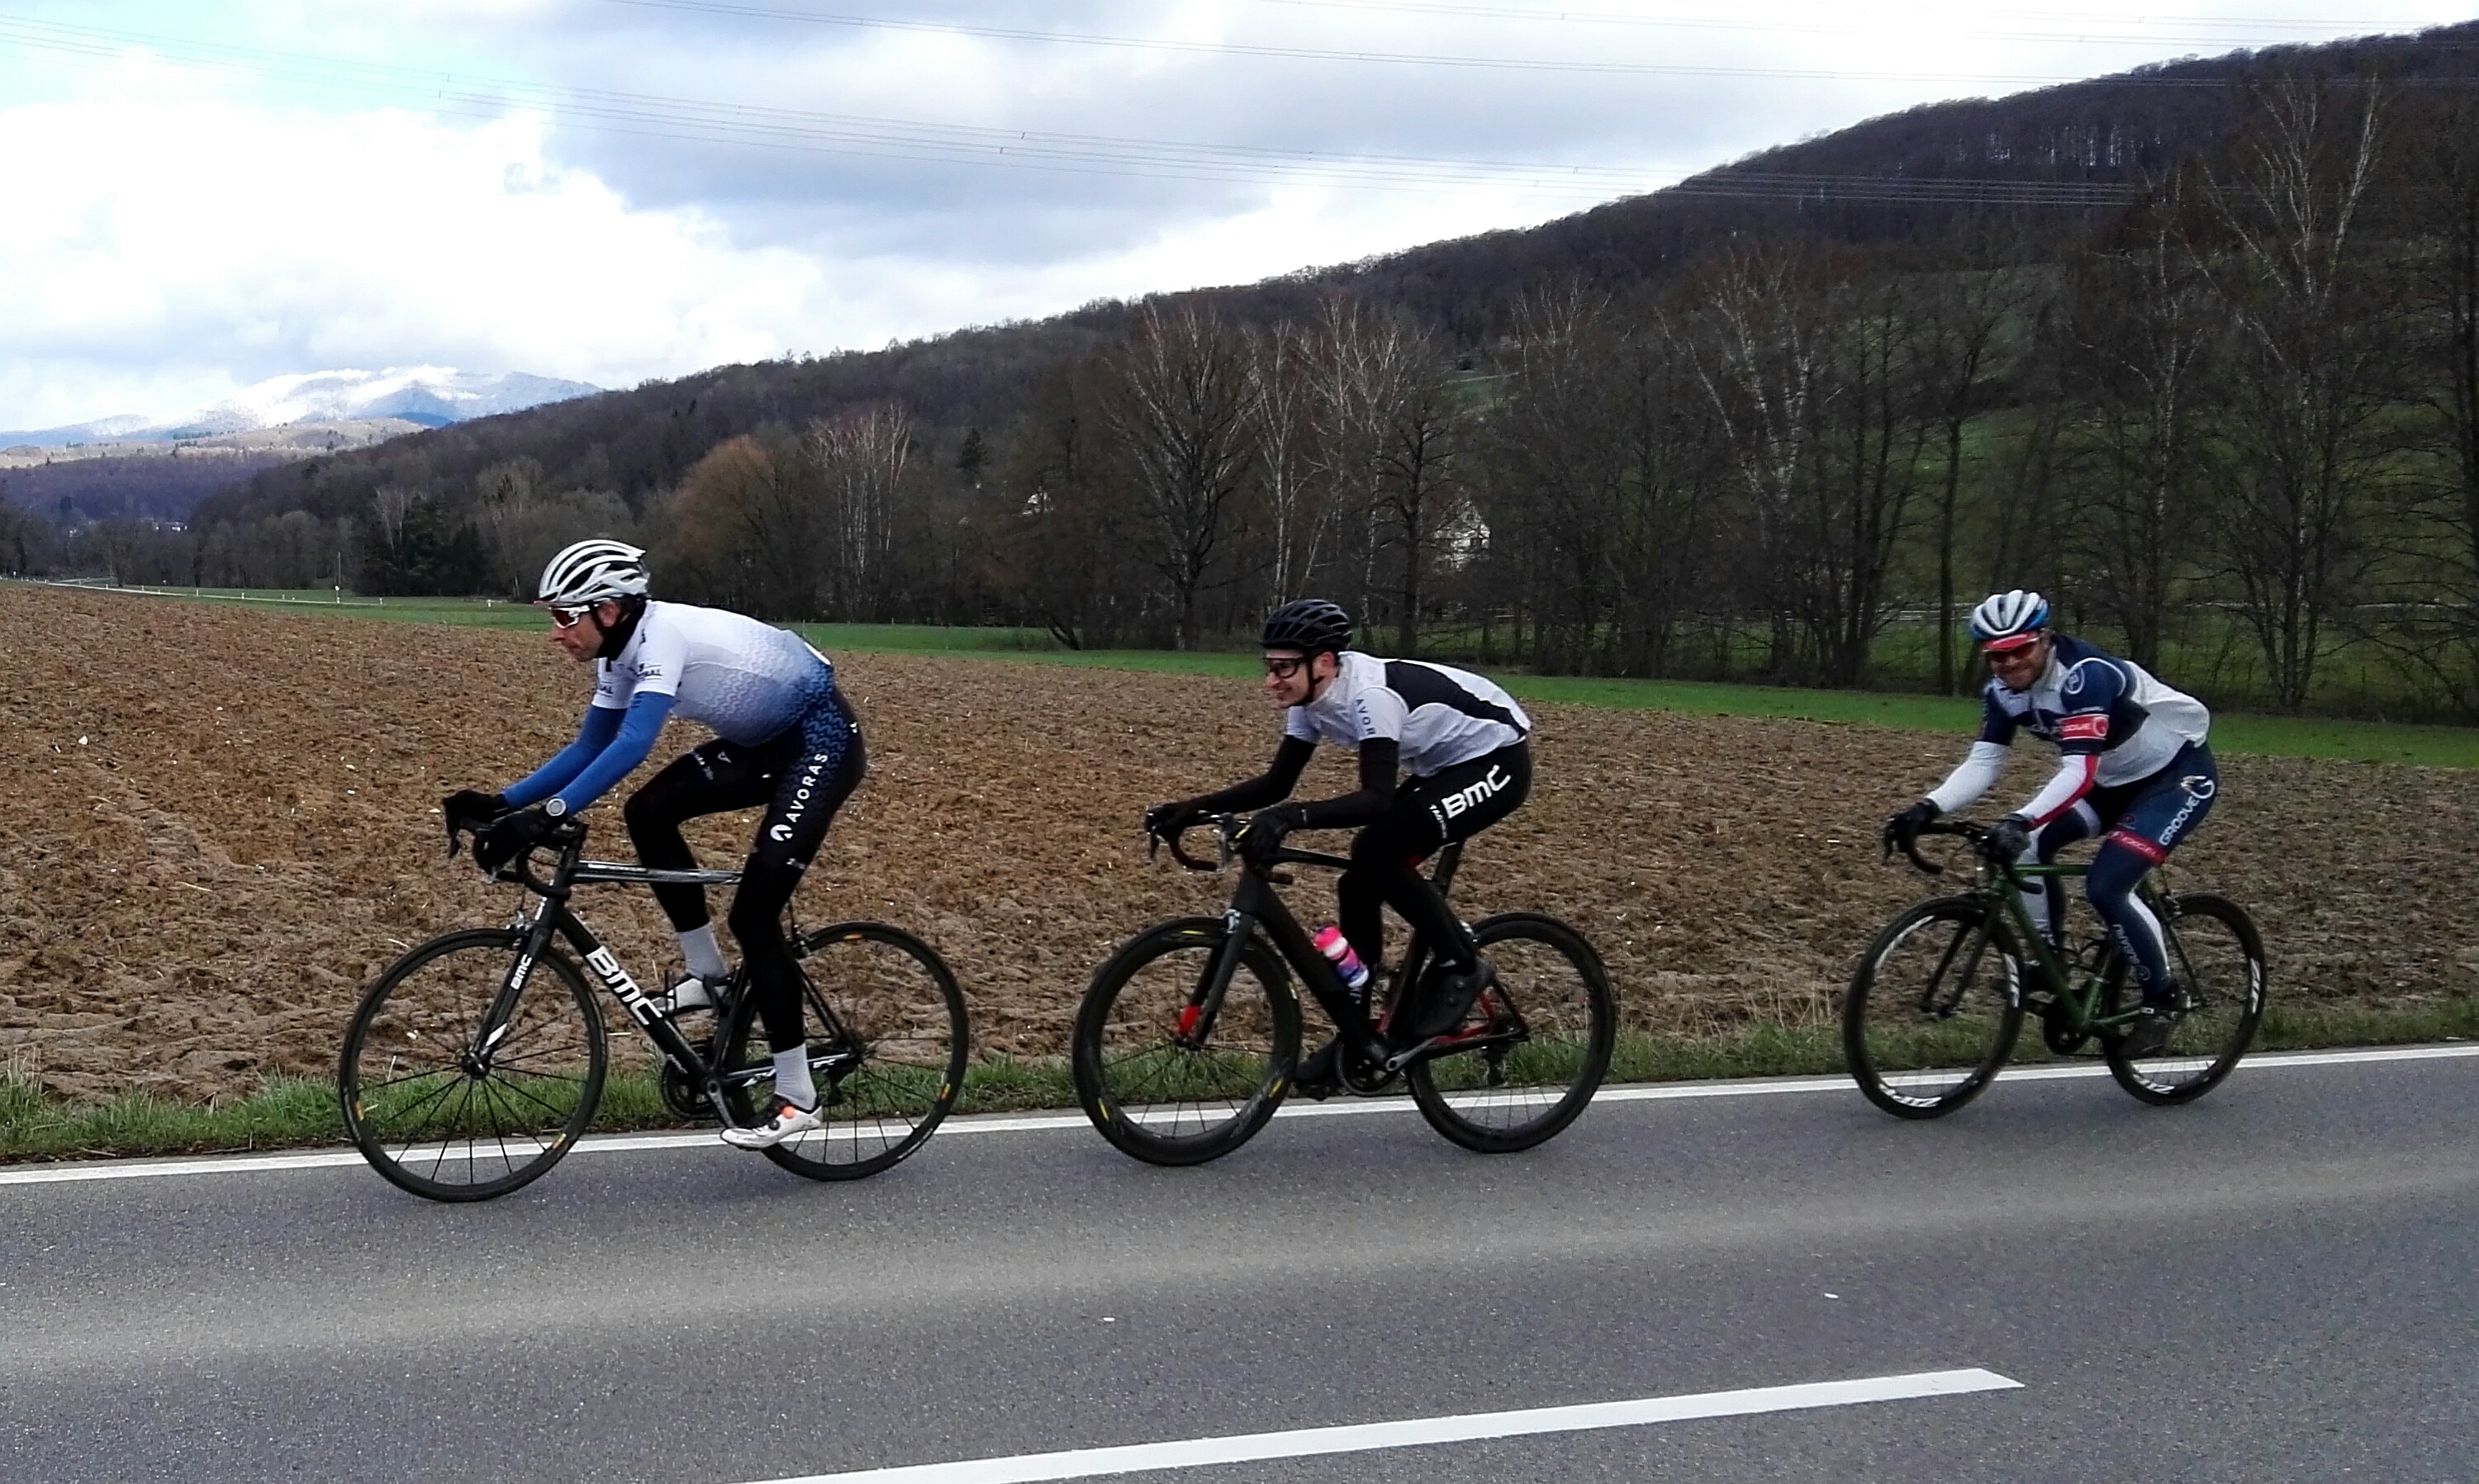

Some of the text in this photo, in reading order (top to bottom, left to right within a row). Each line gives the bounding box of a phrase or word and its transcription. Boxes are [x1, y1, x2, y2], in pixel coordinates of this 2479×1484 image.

[786, 753, 829, 823] AVORAS
[1441, 764, 1512, 819] BMC
[2158, 795, 2200, 846] GROOVE
[510, 953, 533, 990] BMC
[585, 945, 663, 1026] BMC
